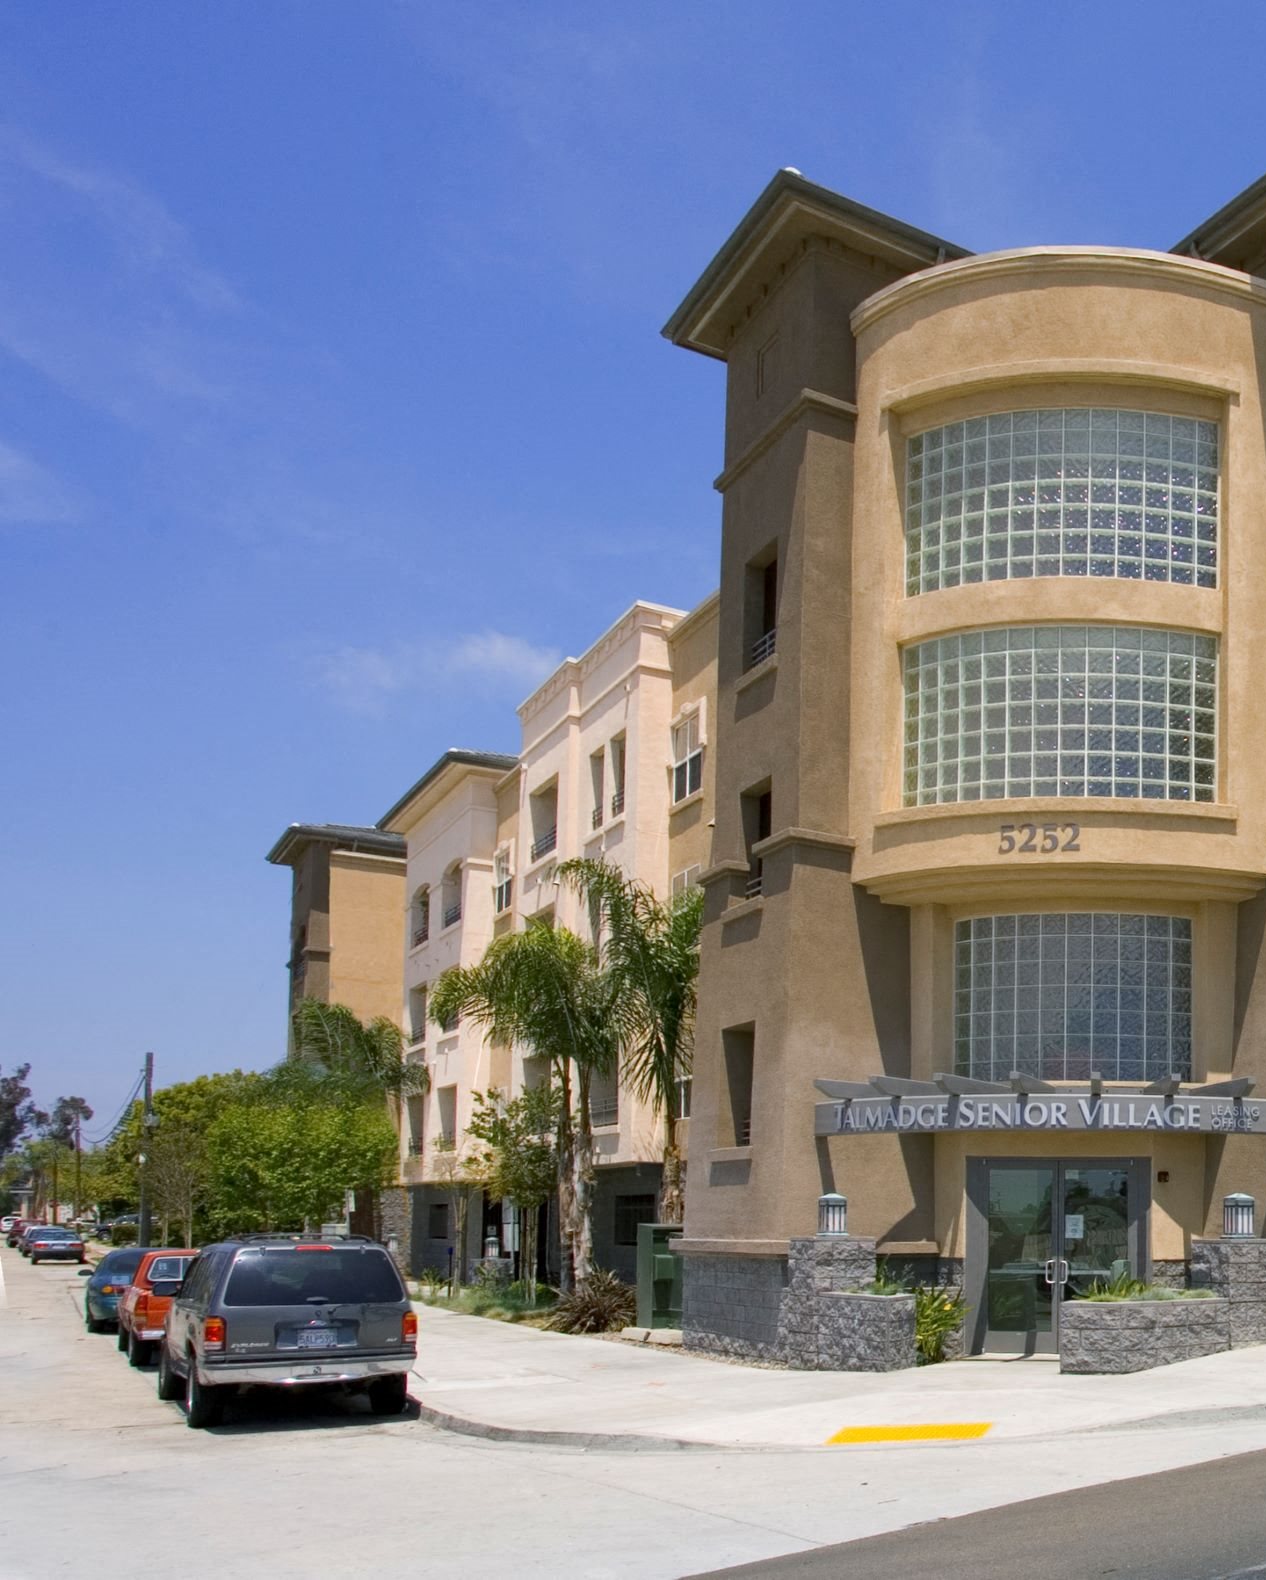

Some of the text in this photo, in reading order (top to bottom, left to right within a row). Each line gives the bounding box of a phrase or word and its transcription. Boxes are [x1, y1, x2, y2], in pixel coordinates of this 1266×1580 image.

[998, 823, 1080, 855] 5252
[833, 1099, 1201, 1130] TALMADGE SENIOR VILLAGE
[1210, 1103, 1260, 1117] LEASING
[1211, 1117, 1254, 1129] OFFICE
